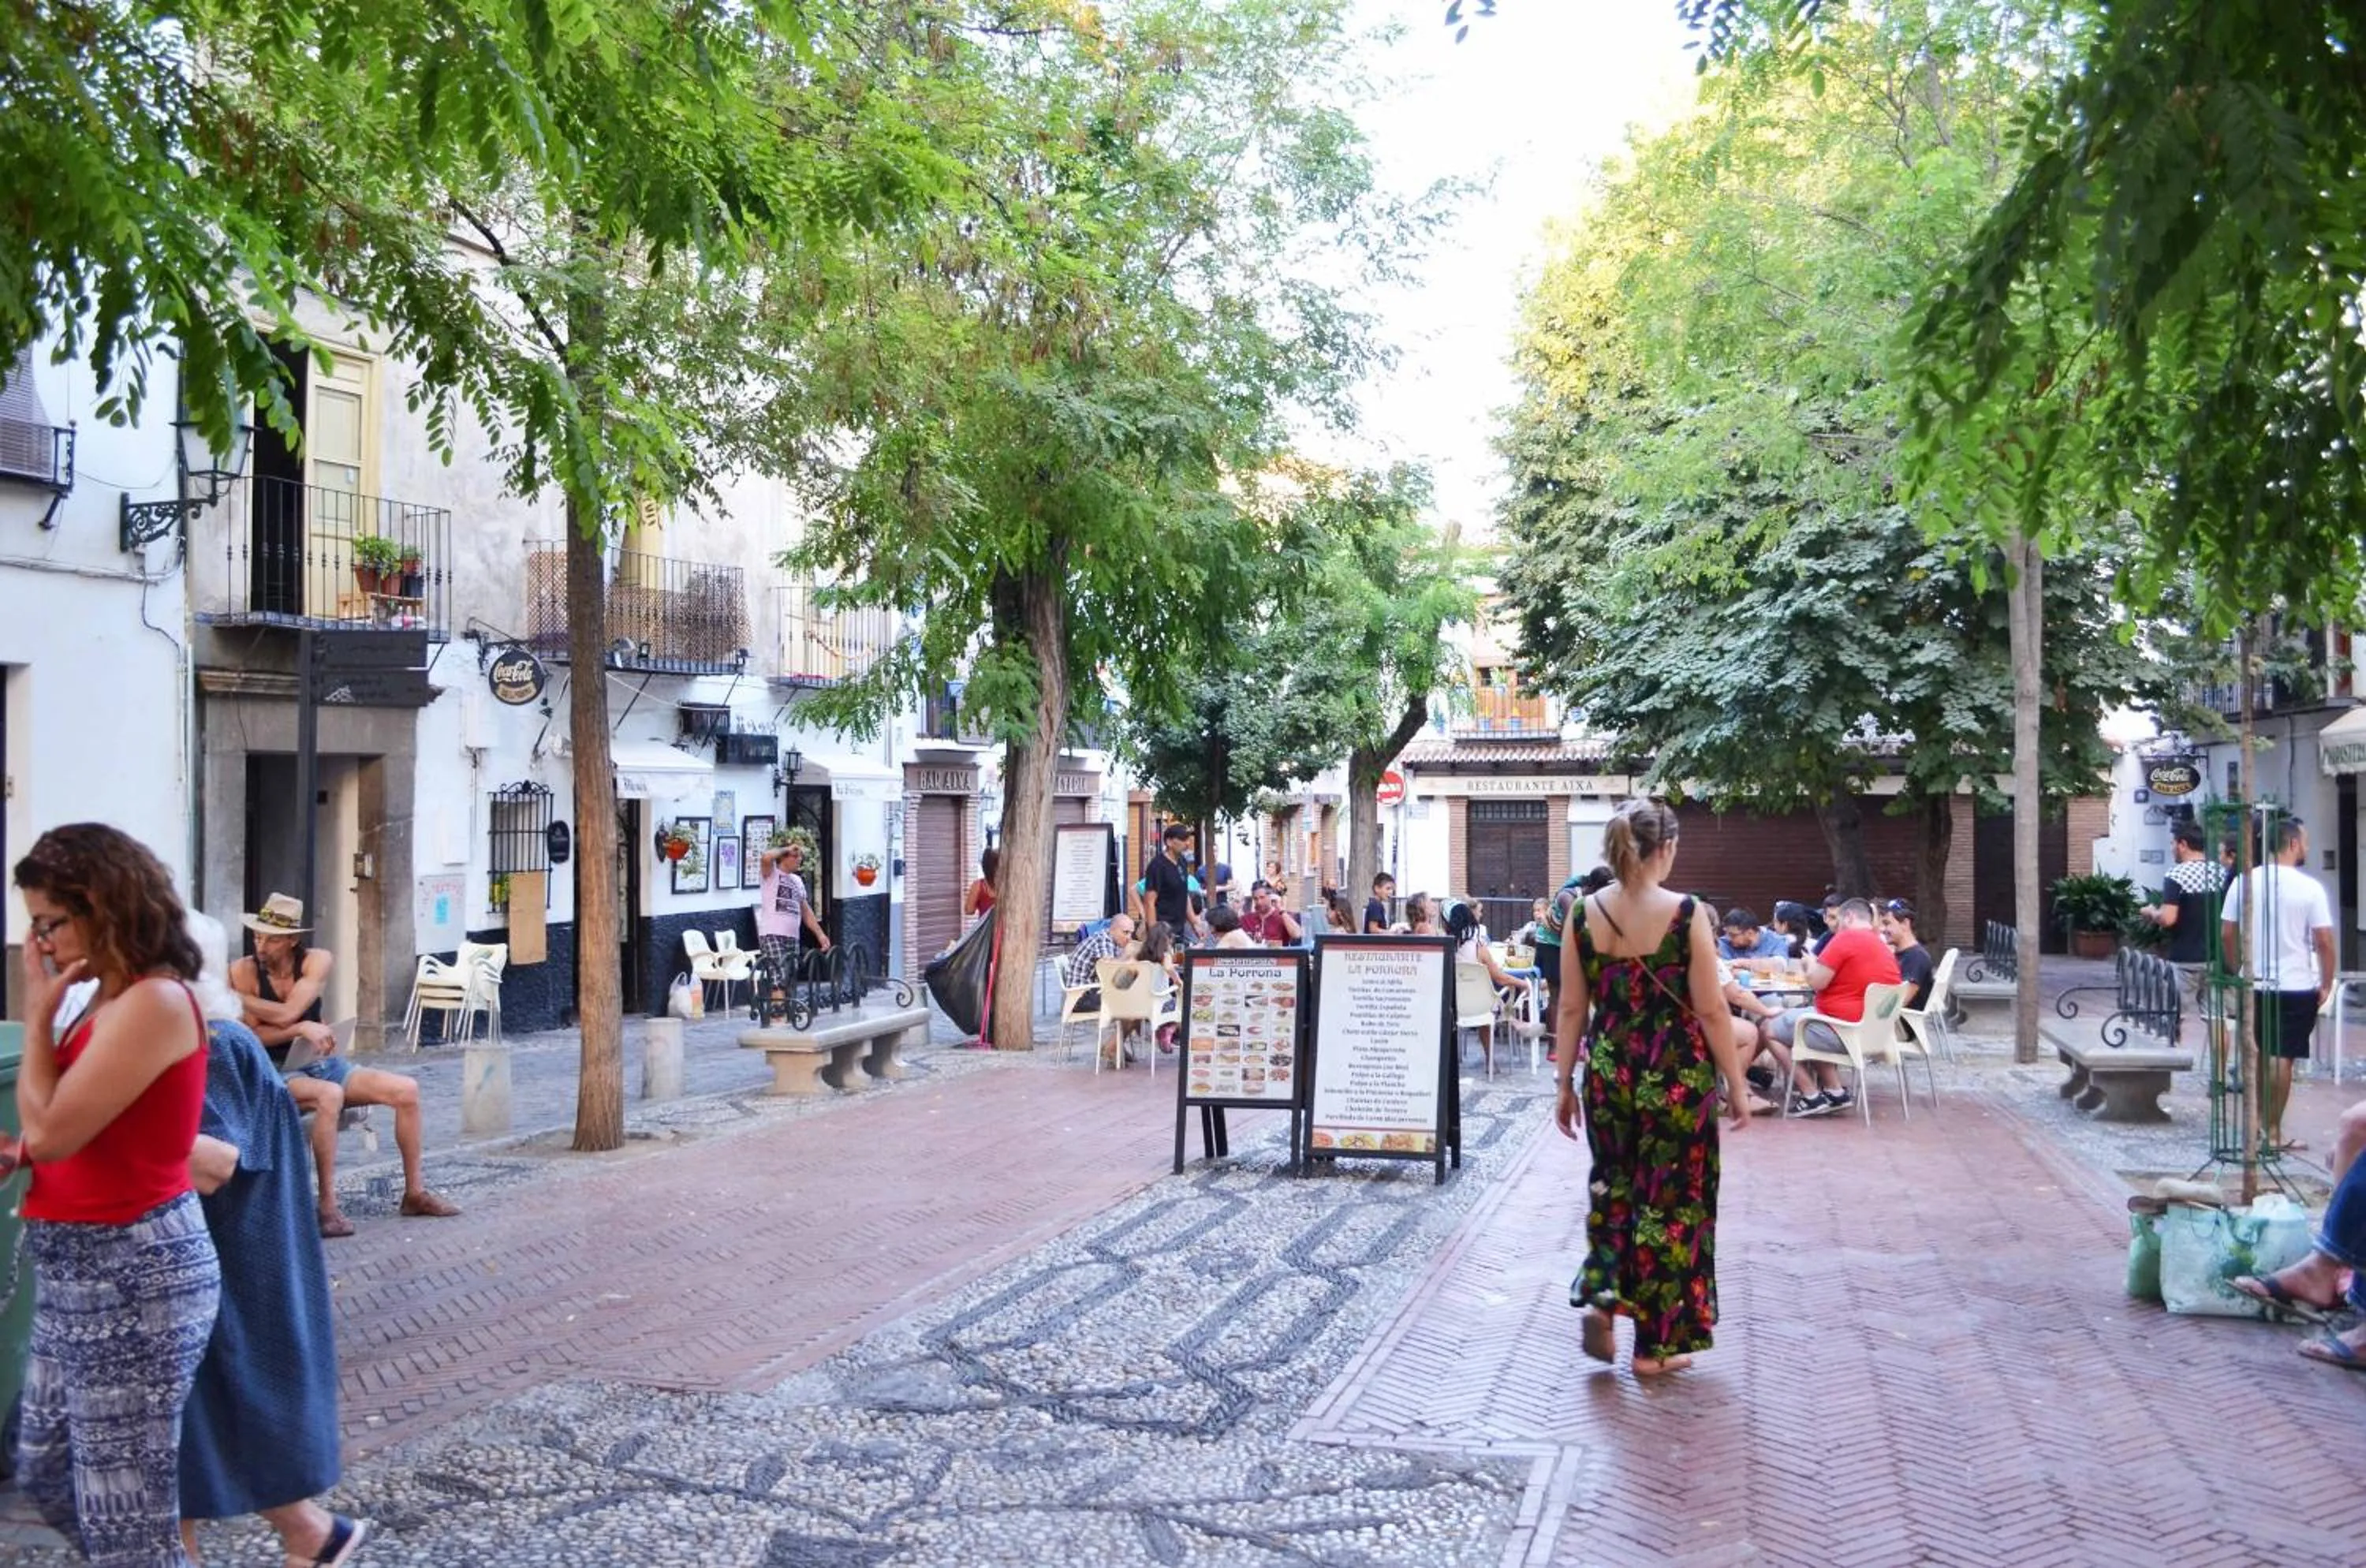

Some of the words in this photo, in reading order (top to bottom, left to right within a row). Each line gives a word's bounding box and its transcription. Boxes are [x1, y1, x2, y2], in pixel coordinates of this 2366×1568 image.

[921, 770, 940, 790] BAR
[945, 770, 971, 790] AIXA
[1467, 780, 1556, 791] RESTAURANTE
[1561, 780, 1592, 791] AIXA
[1209, 968, 1225, 977] La
[1230, 968, 1282, 978] Porrona
